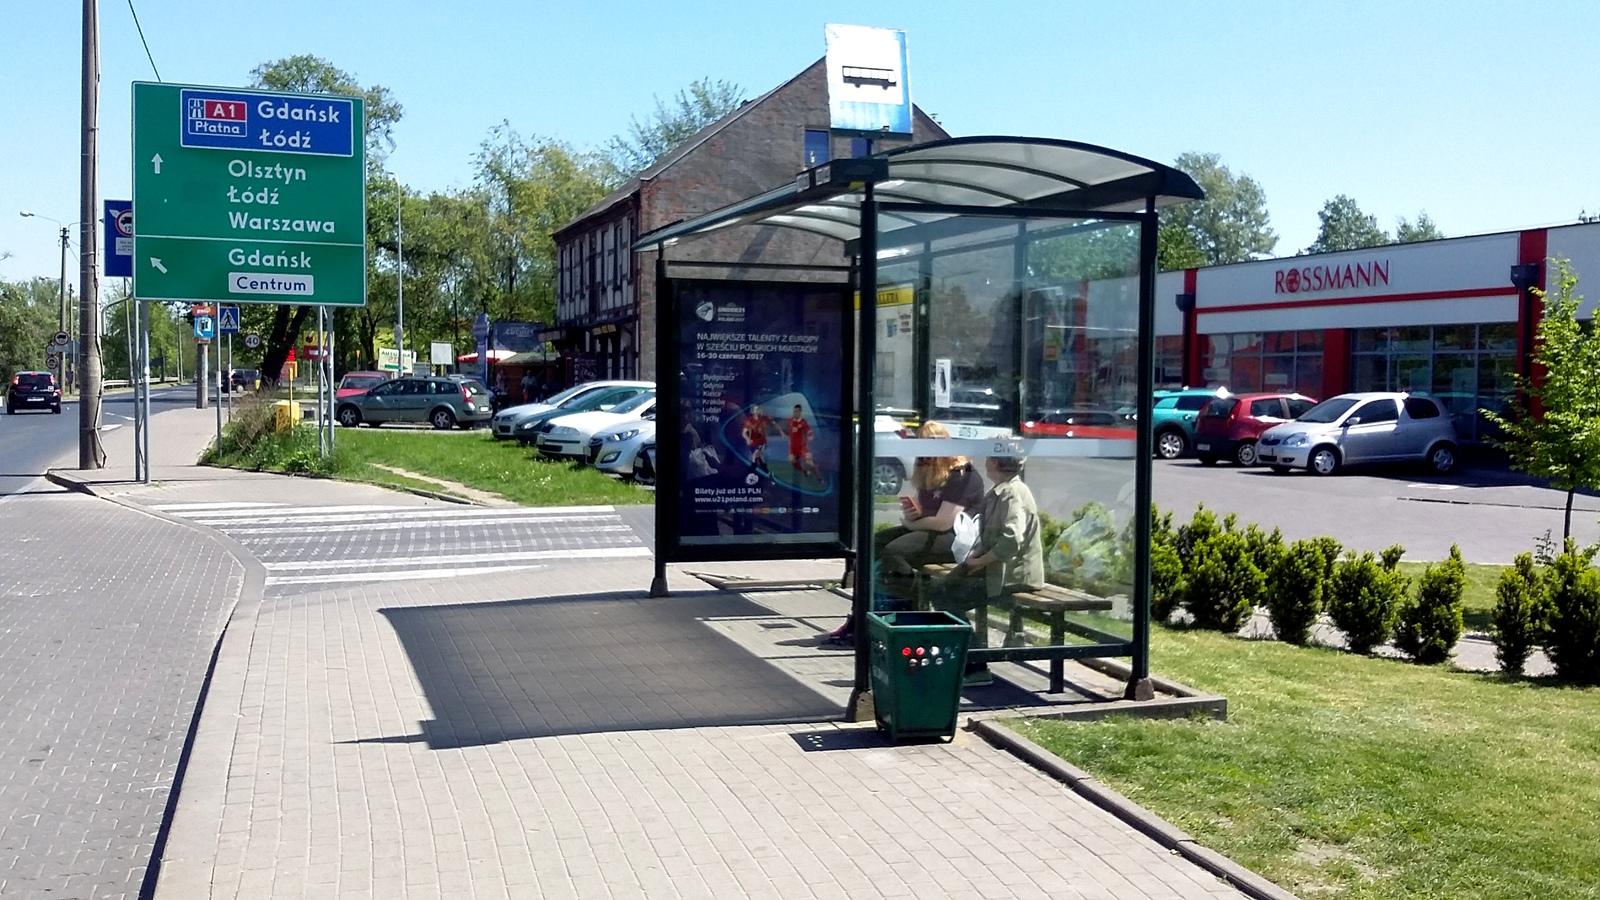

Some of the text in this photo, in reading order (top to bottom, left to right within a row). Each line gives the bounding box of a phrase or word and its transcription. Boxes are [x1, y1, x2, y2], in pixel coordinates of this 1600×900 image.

[212, 102, 237, 119] A1
[257, 100, 340, 123] Gdańsk
[195, 121, 240, 135] Płatna
[259, 128, 312, 149] Łódź
[228, 159, 307, 185] Olsztyn
[227, 185, 280, 205] Łódź
[229, 211, 335, 234] Warszawa
[228, 248, 312, 269] Gdańsk
[236, 276, 307, 292] Centrum
[1274, 259, 1389, 295] ROSSMANN
[246, 337, 259, 345] 40
[696, 333, 820, 344] NAJWIĘKSZE TALENTY Z EUROPY
[696, 343, 705, 351] W
[706, 342, 739, 352] SZEŚCIU
[739, 344, 777, 352] POLSKICH
[746, 353, 765, 361] 2017
[702, 414, 720, 423] Tychy
[716, 488, 726, 496] już
